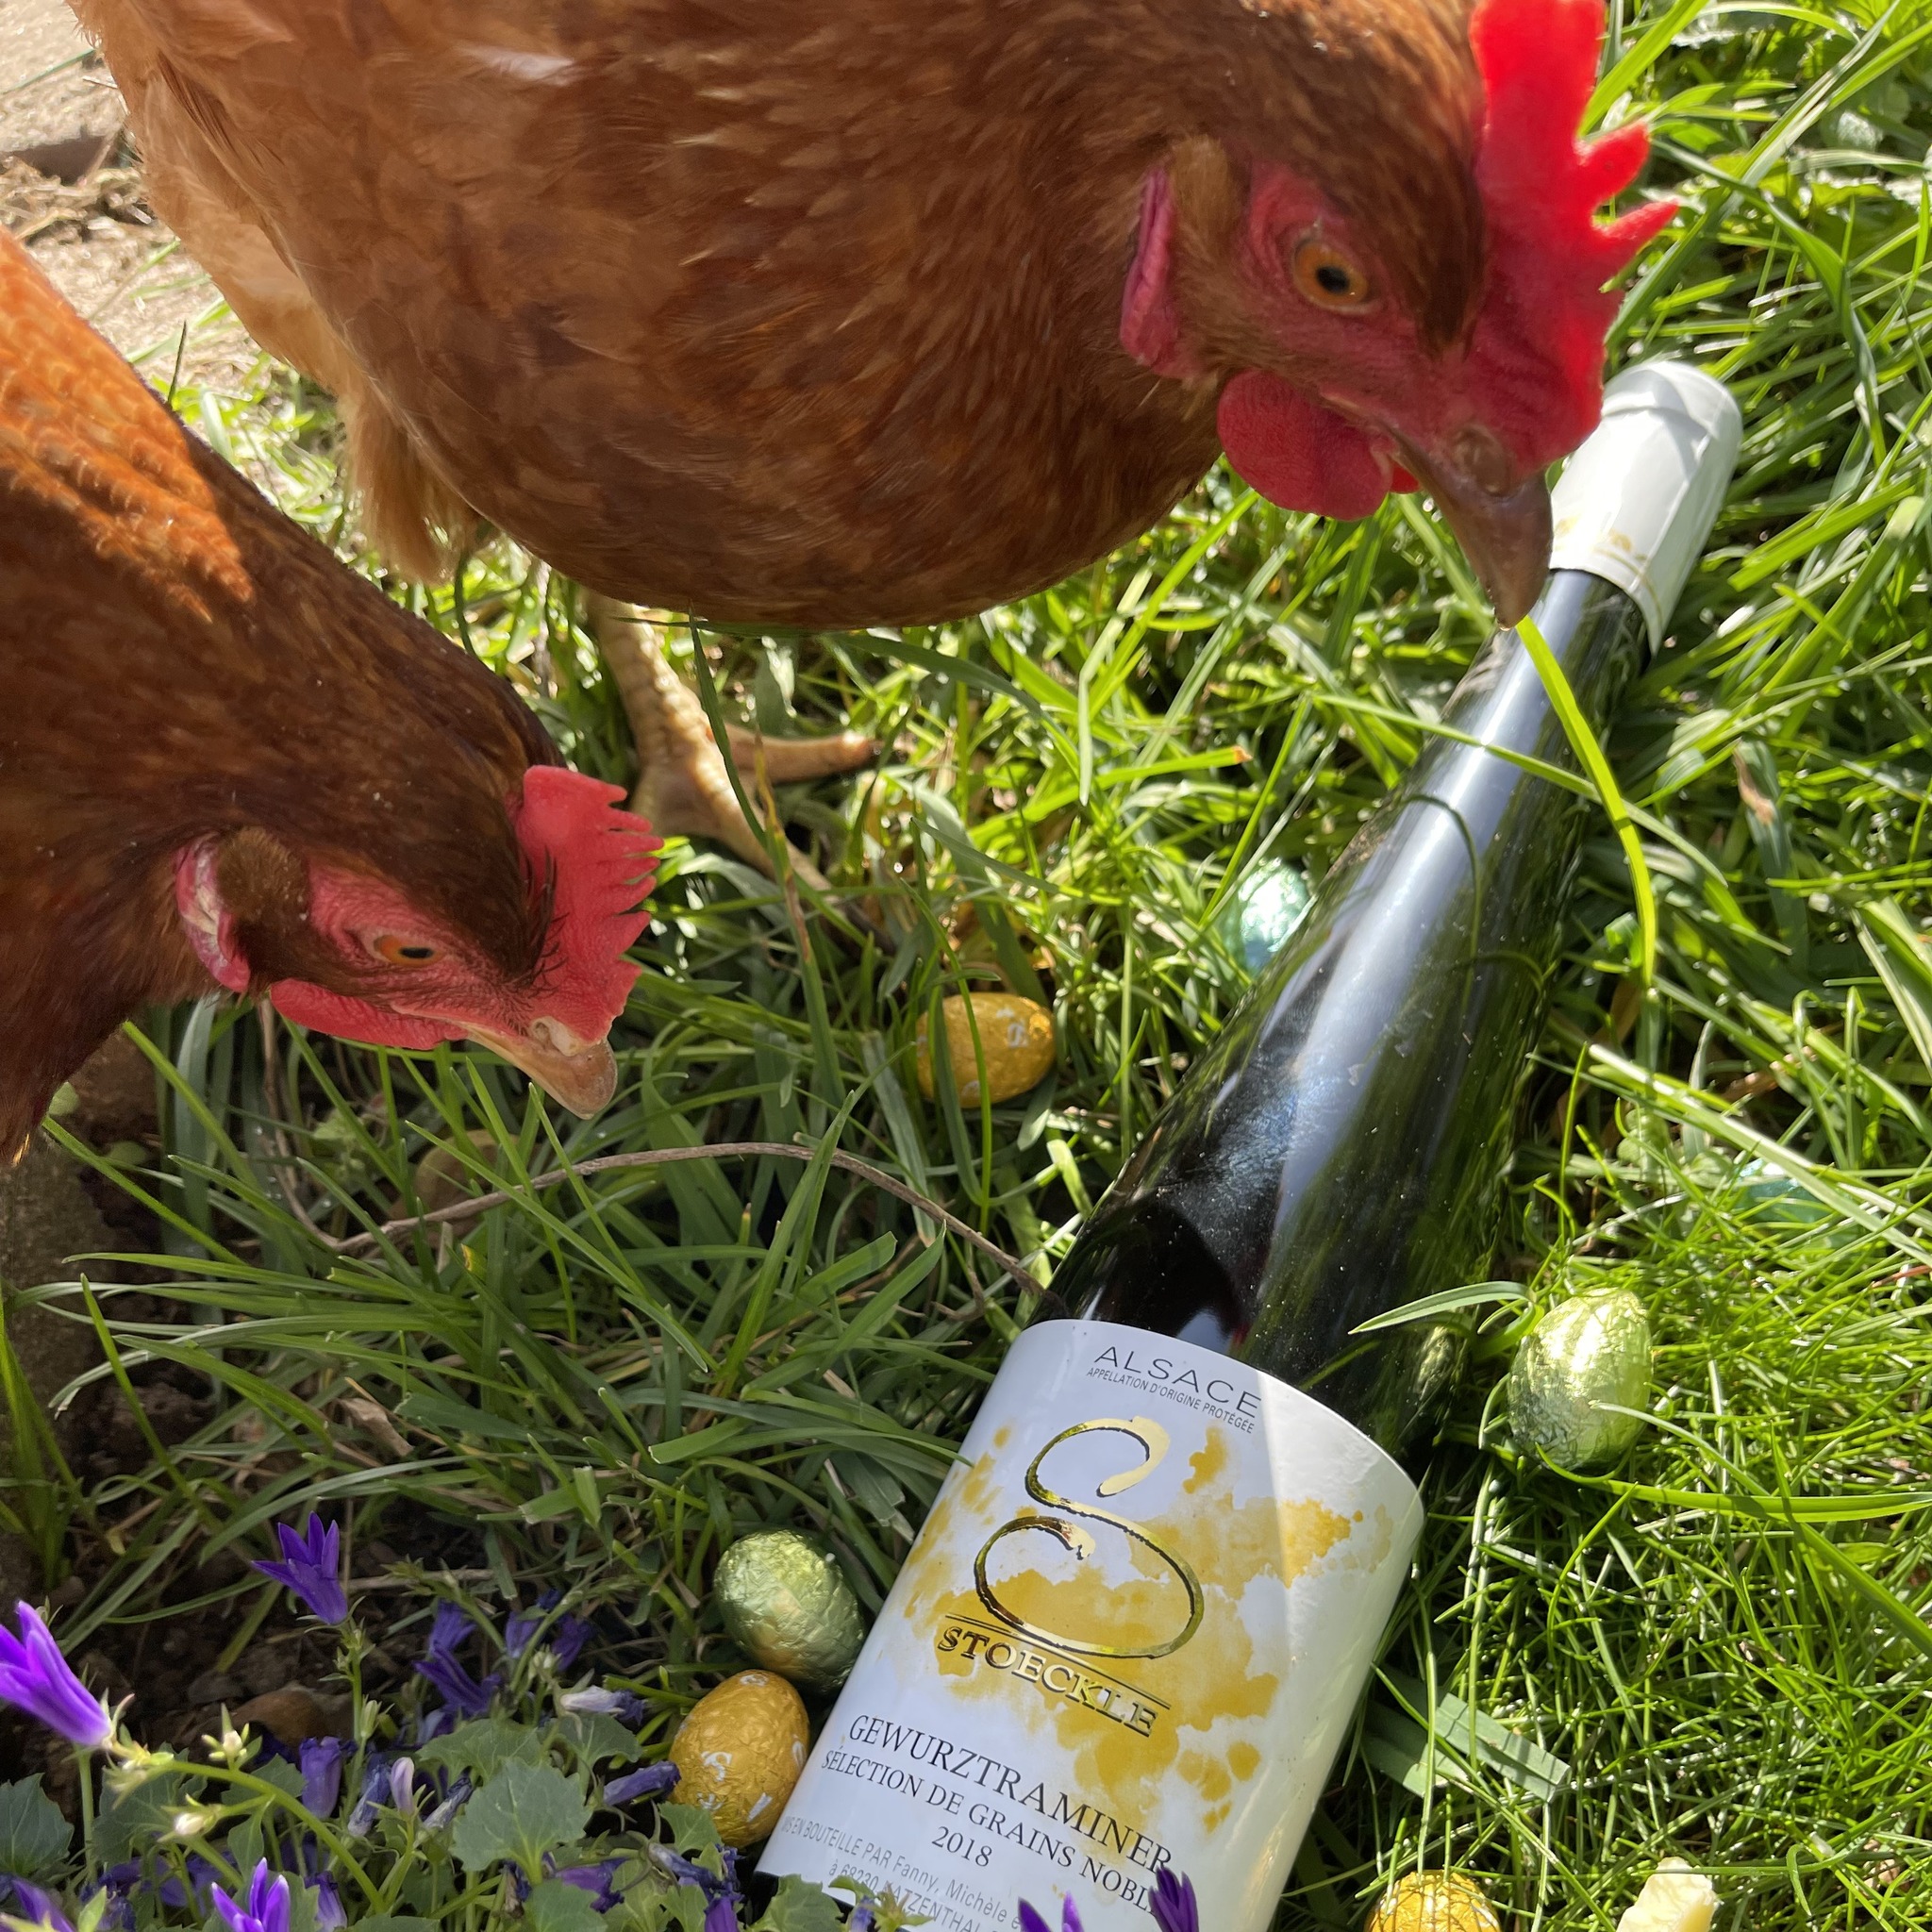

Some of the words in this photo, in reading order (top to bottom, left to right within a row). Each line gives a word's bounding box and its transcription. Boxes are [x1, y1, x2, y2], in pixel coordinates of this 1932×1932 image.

[1087, 1367, 1149, 1391] APPELLATION
[1149, 1382, 1202, 1411] D'ORIGINE
[1202, 1402, 1255, 1434] PROTÉGÉE
[1093, 1345, 1262, 1419] ALSACE
[937, 1625, 1159, 1738] STOECKLE
[821, 1745, 925, 1798] SÉLECTION
[925, 1783, 965, 1816] DE
[968, 1803, 1076, 1868] GRAINS
[1078, 1855, 1156, 1916] NOBL
[849, 1714, 1173, 1874] GEWURZTRAMINER
[803, 1821, 864, 1856] BOUTEILLE
[861, 1842, 892, 1869] PAR
[892, 1855, 940, 1894] Fanny,
[944, 1878, 1008, 1924] Michèle
[828, 1858, 839, 1876] à
[931, 1825, 993, 1868] 2018
